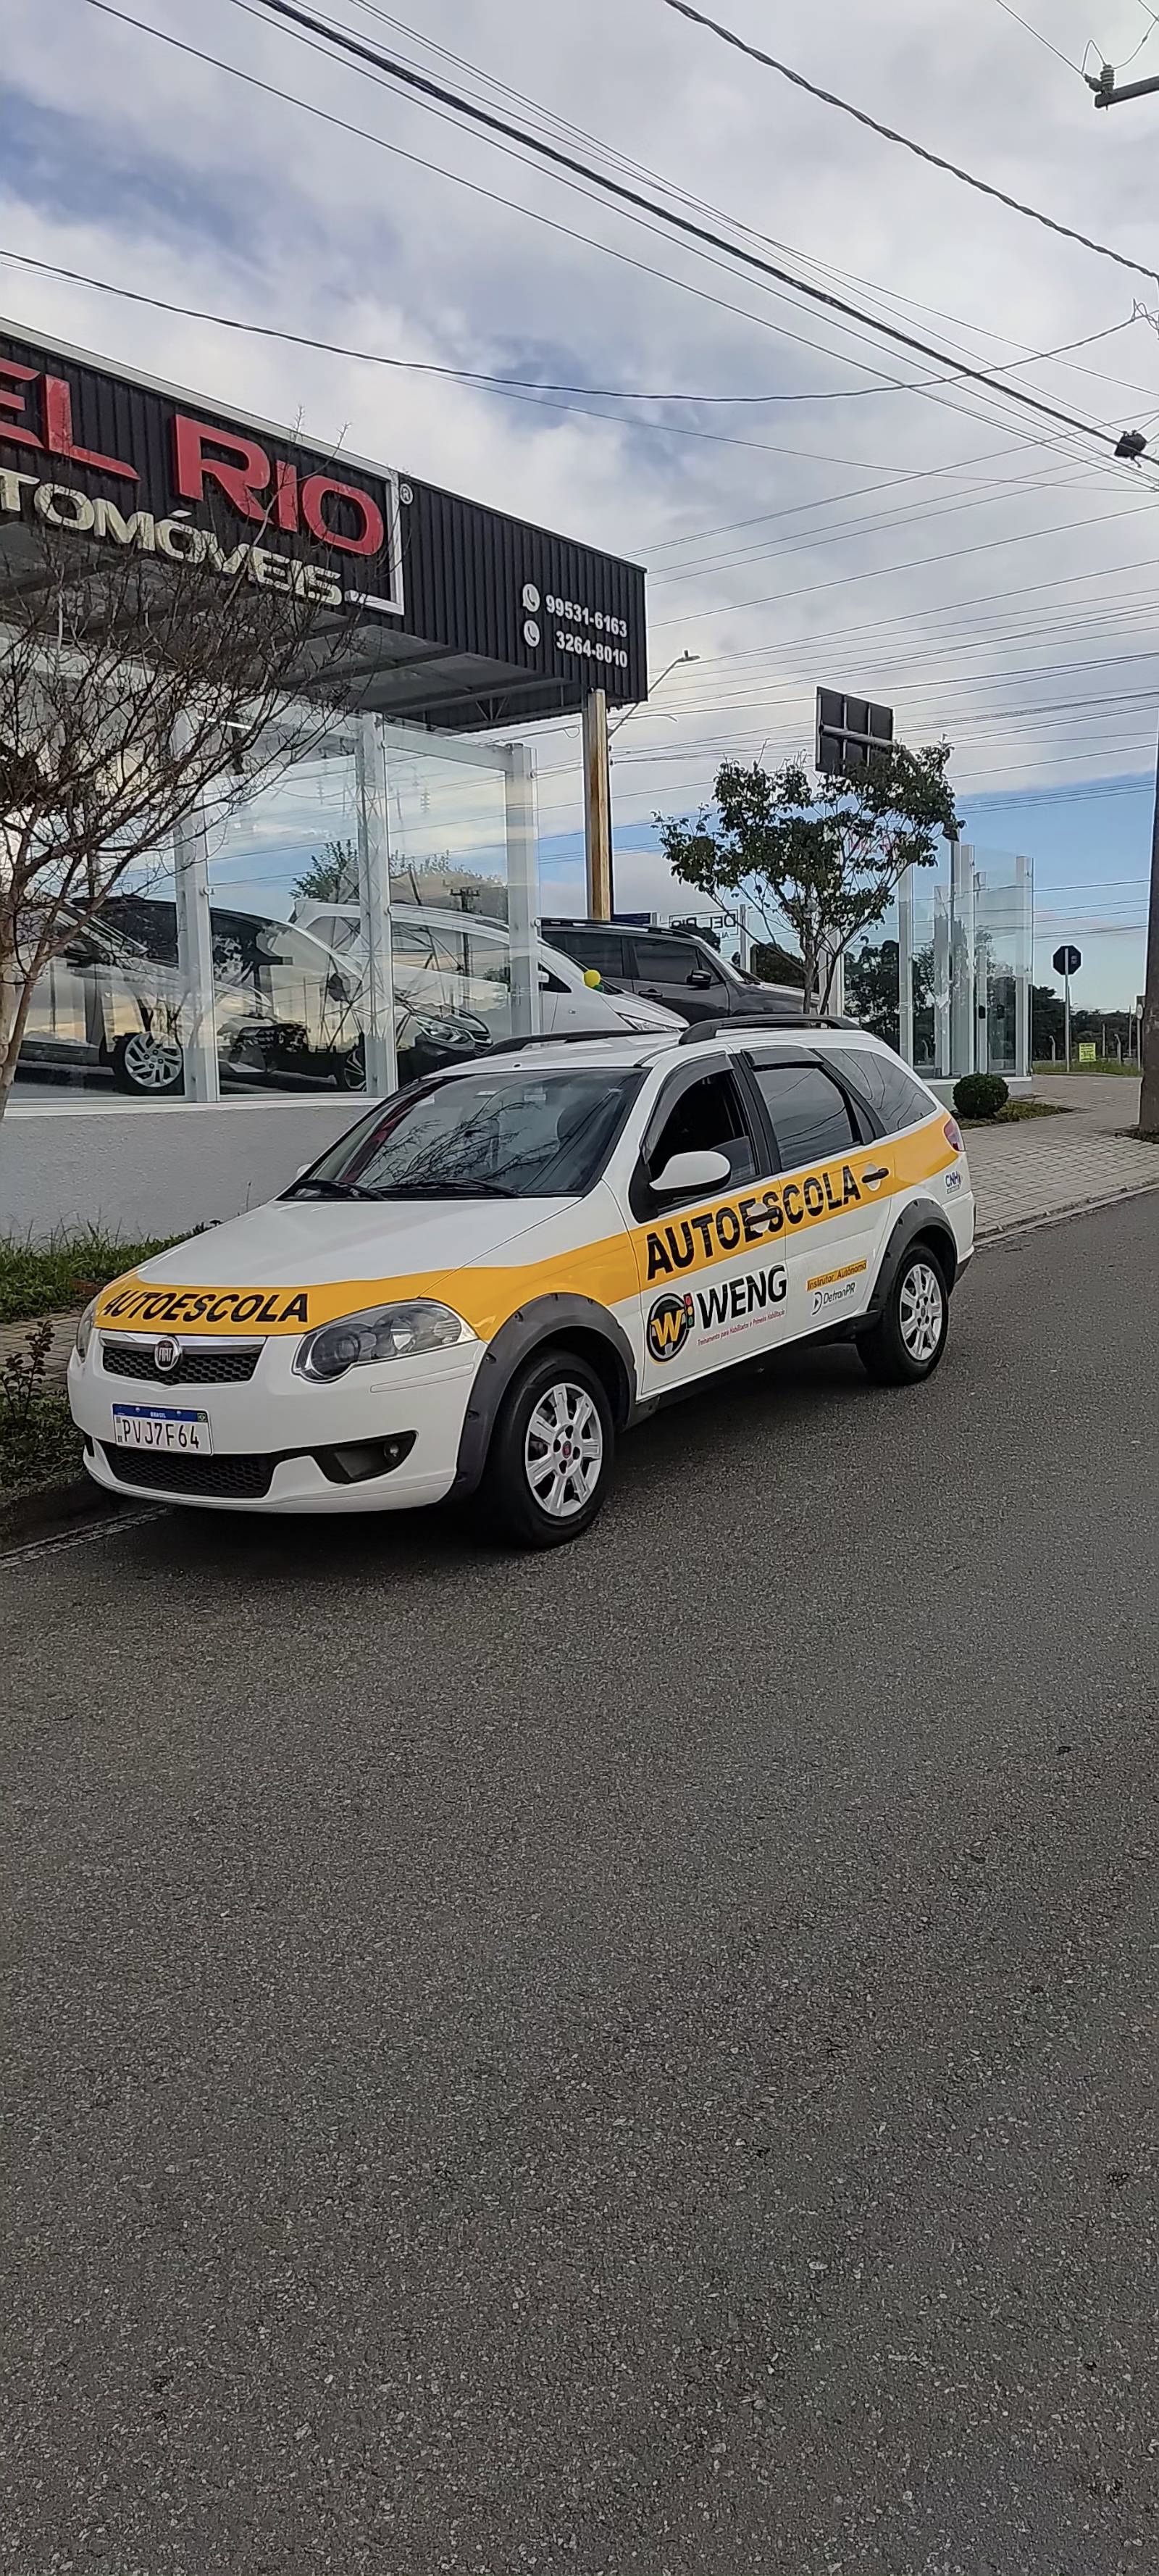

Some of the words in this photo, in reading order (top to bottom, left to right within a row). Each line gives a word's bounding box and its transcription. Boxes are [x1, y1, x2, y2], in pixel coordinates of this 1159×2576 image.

[176, 414, 385, 556] RIO
[545, 595, 627, 638] 99531-6163
[556, 630, 628, 667] 3264-8010
[647, 1165, 861, 1280] AUTOESCOLA
[697, 1264, 787, 1330] WENG
[807, 1273, 834, 1290] Instrutor
[824, 1283, 855, 1304] DetranPR
[99, 1290, 309, 1323] AUTOESCOLA
[122, 1419, 199, 1449] PVJ7F64
